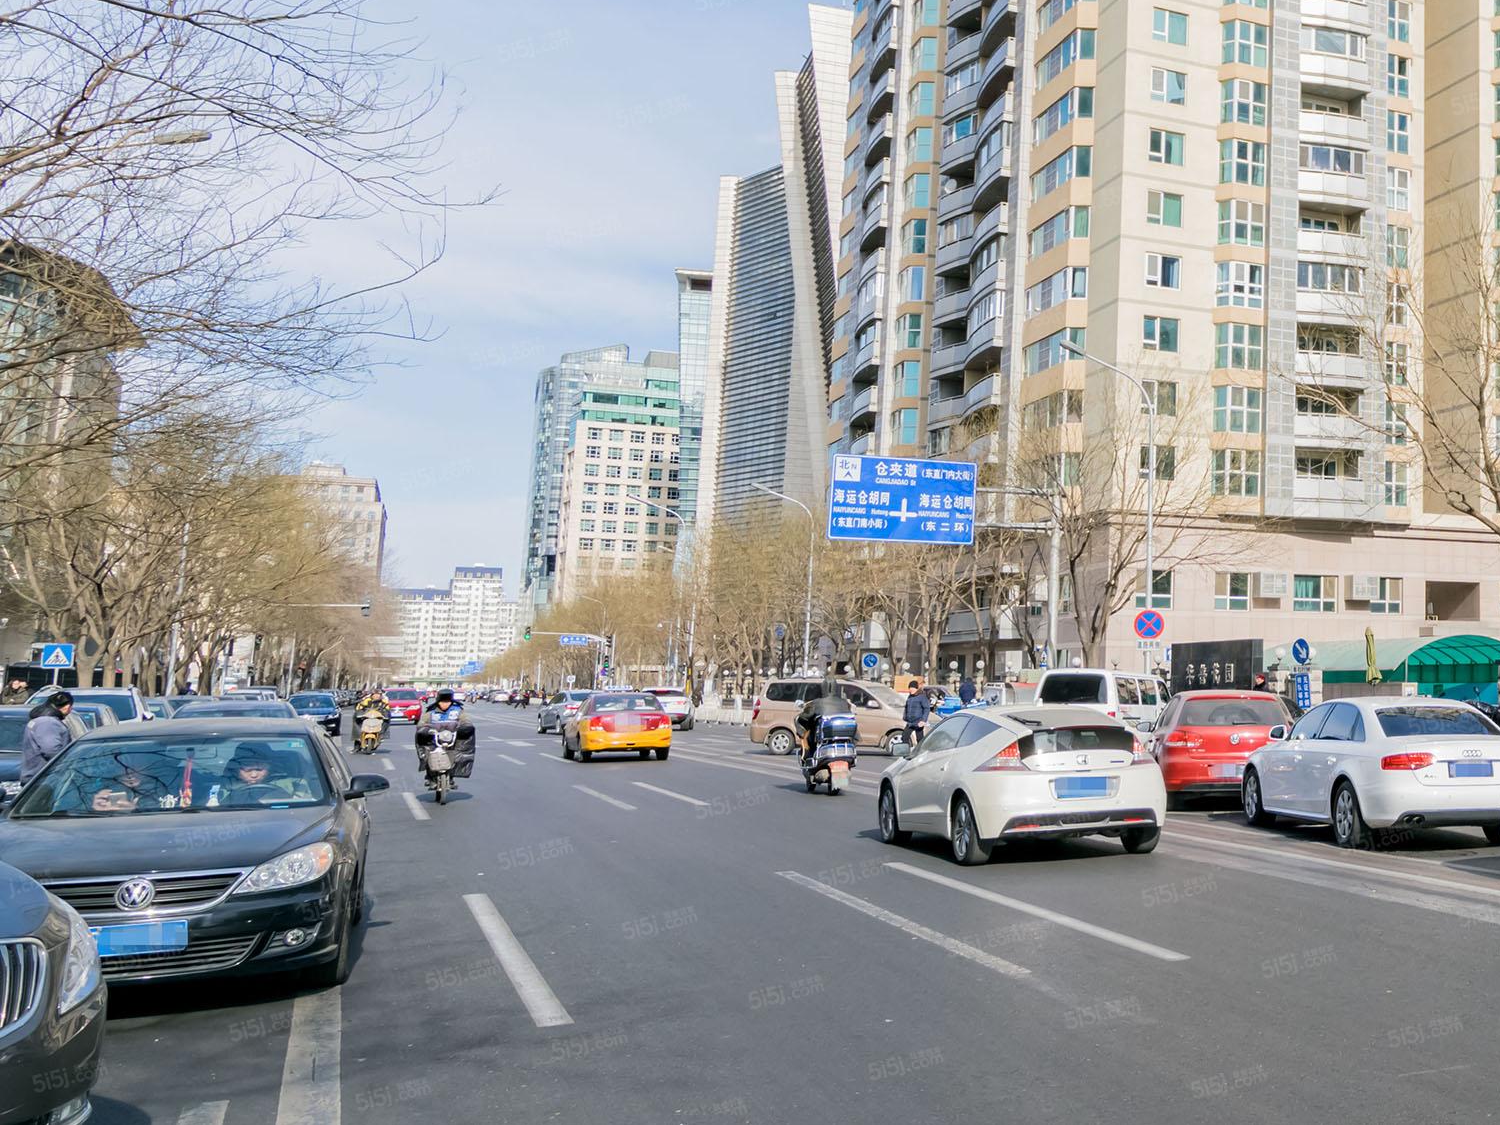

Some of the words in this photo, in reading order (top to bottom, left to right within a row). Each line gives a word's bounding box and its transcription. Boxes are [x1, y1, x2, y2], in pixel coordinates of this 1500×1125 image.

[839, 459, 849, 470] 北
[875, 461, 918, 478] 仓夹道
[833, 488, 890, 506] 海运仓胡同
[919, 493, 973, 510] 海运仓胡同
